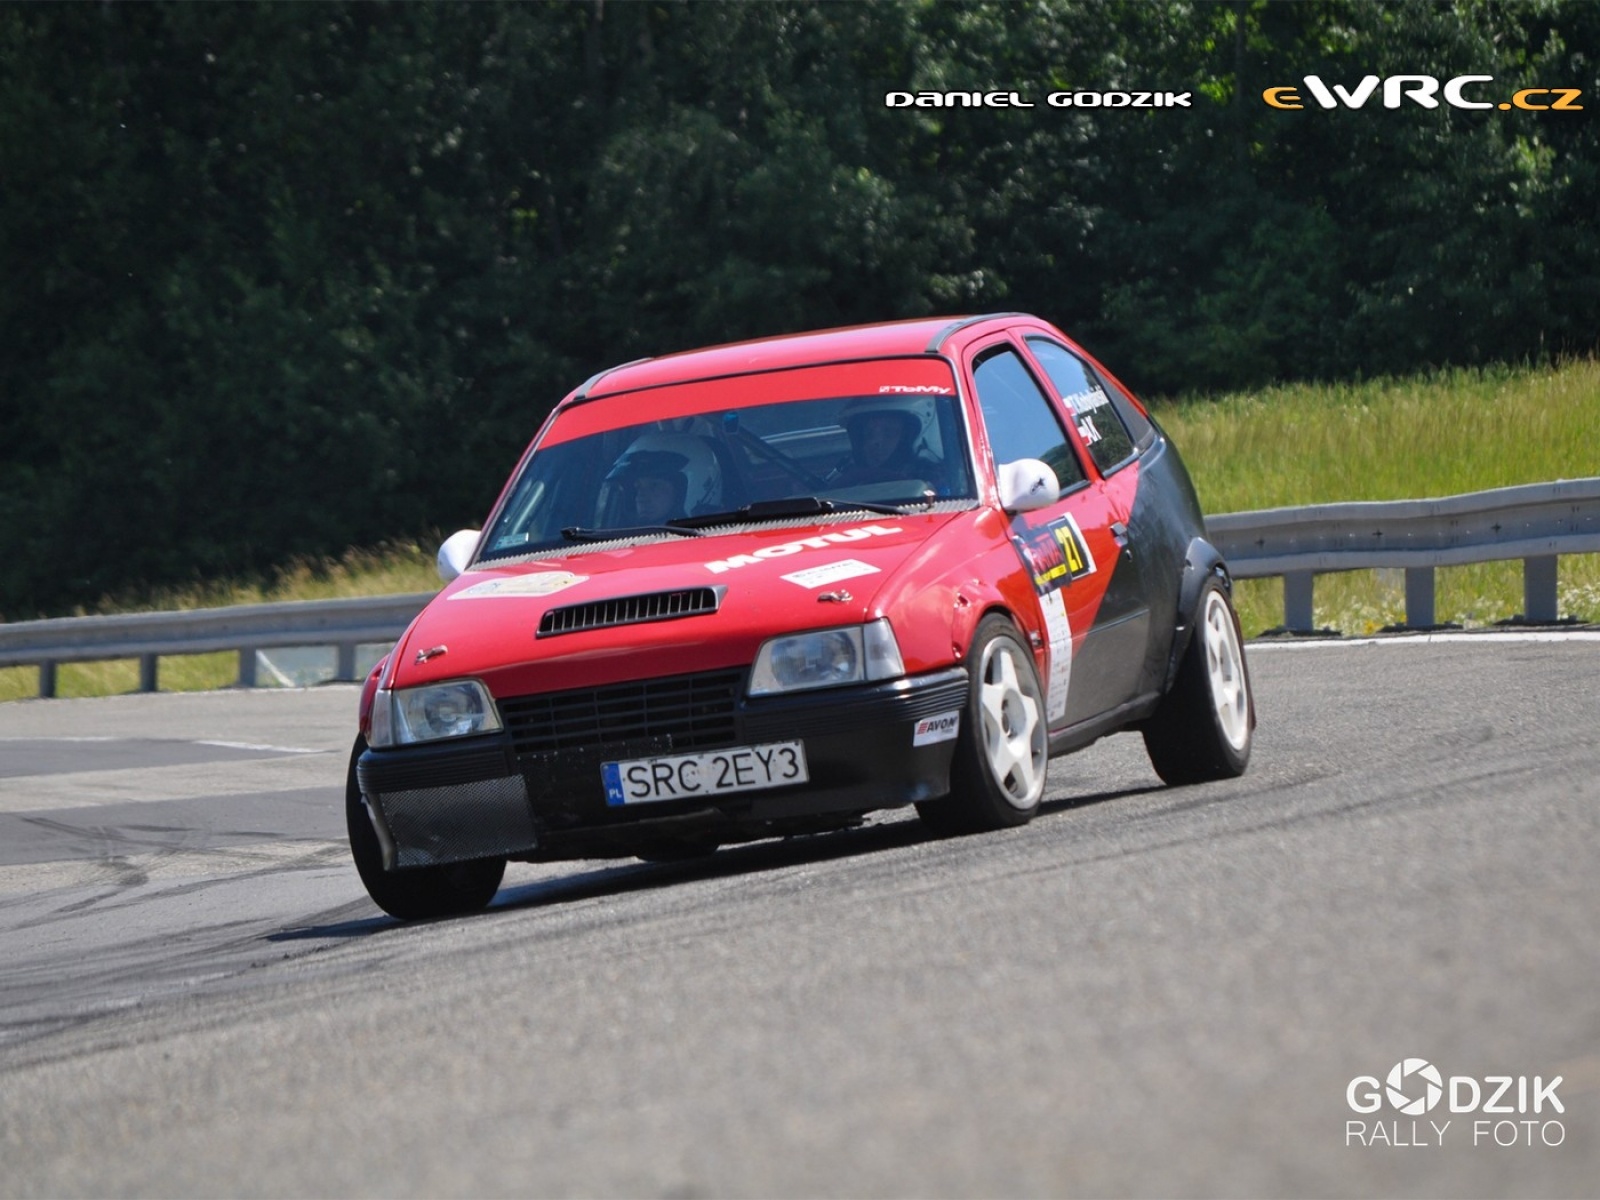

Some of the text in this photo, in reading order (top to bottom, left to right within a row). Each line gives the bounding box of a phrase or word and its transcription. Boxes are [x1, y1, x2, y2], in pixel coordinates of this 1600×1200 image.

[704, 525, 903, 574] MOTUL
[1054, 525, 1084, 572] 27
[927, 716, 958, 733] AVON
[609, 789, 622, 799] PL
[627, 748, 799, 798] SRC 2EY3
